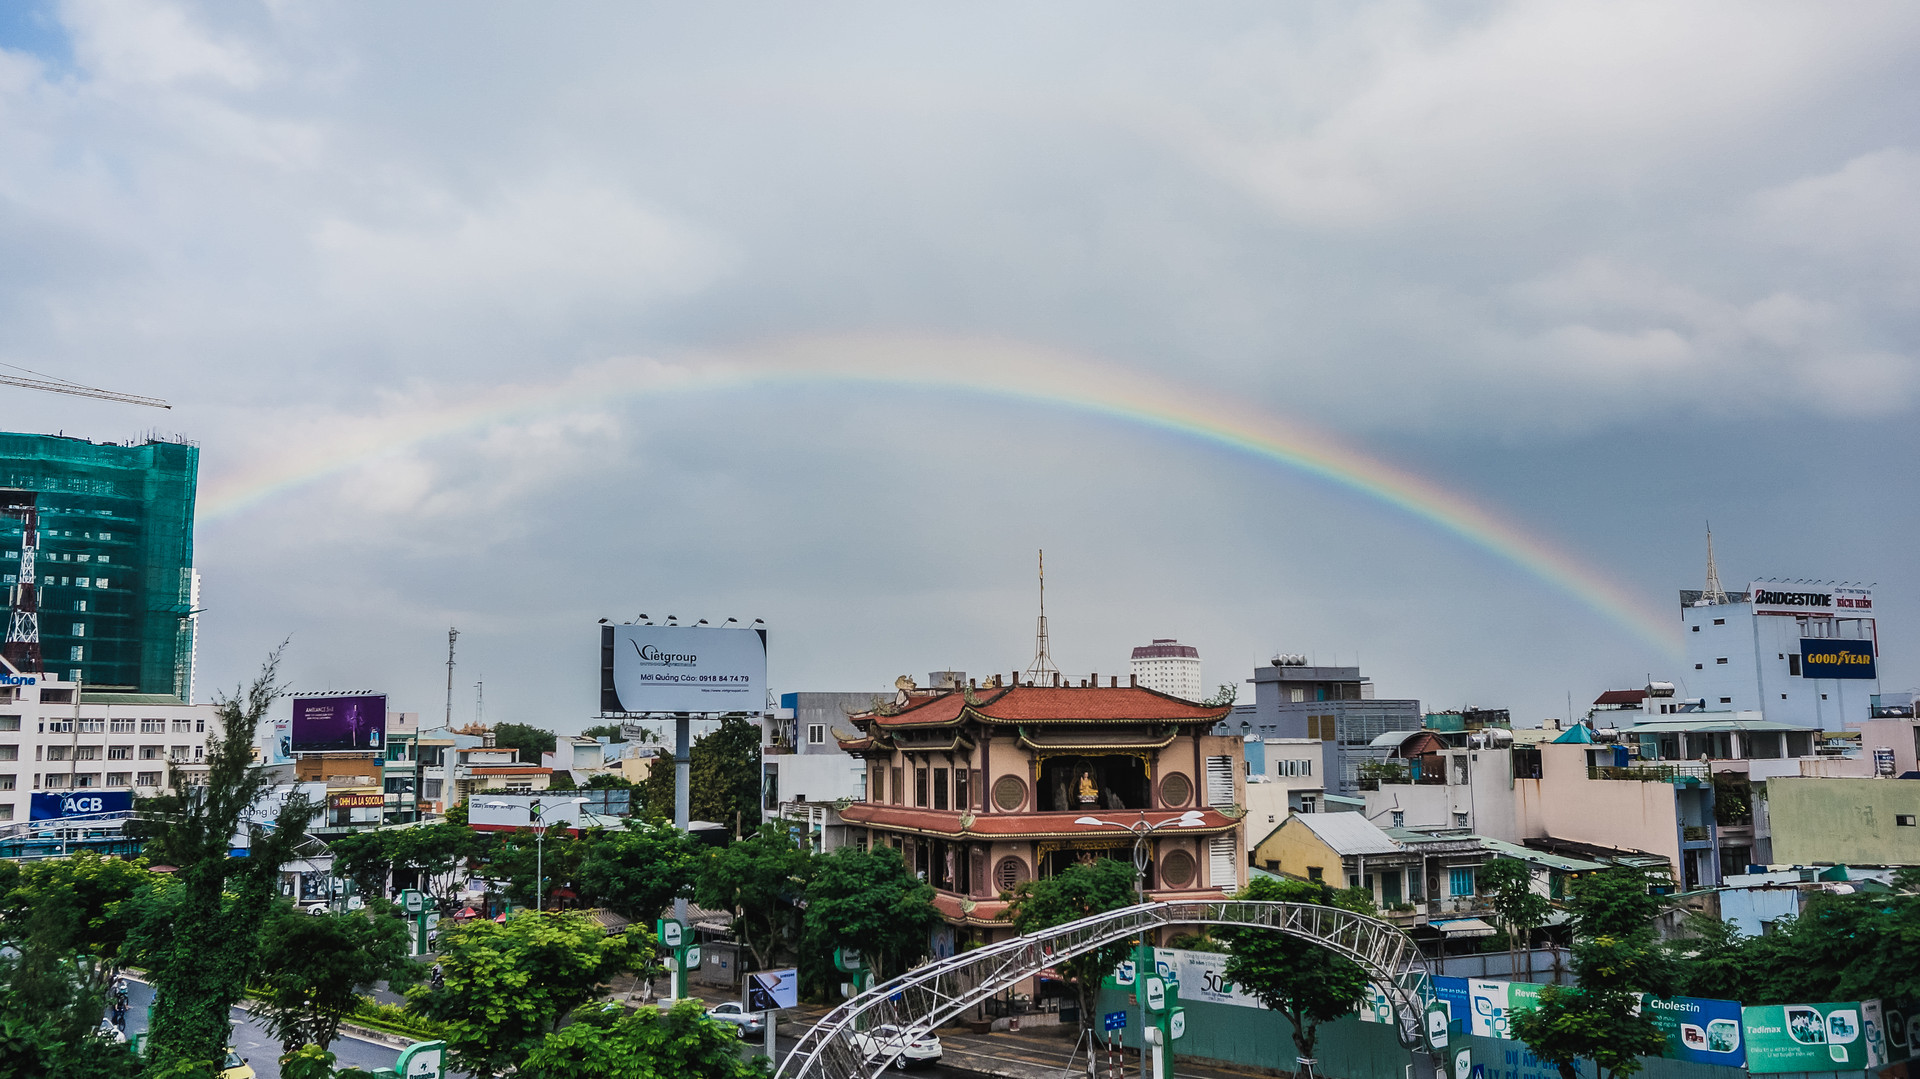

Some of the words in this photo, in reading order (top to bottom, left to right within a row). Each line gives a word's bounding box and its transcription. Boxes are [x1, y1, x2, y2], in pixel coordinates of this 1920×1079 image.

[1755, 589, 1832, 607] BRIDGESTONE
[699, 675, 717, 683] 0918
[718, 675, 728, 683] 84
[65, 798, 103, 812] ACB
[340, 797, 351, 806] OHH
[351, 797, 358, 806] LA
[358, 797, 365, 805] LA
[365, 796, 384, 805] SOCOLA
[1651, 999, 1700, 1013] Cholestin
[1746, 1026, 1782, 1034] Tadimax
